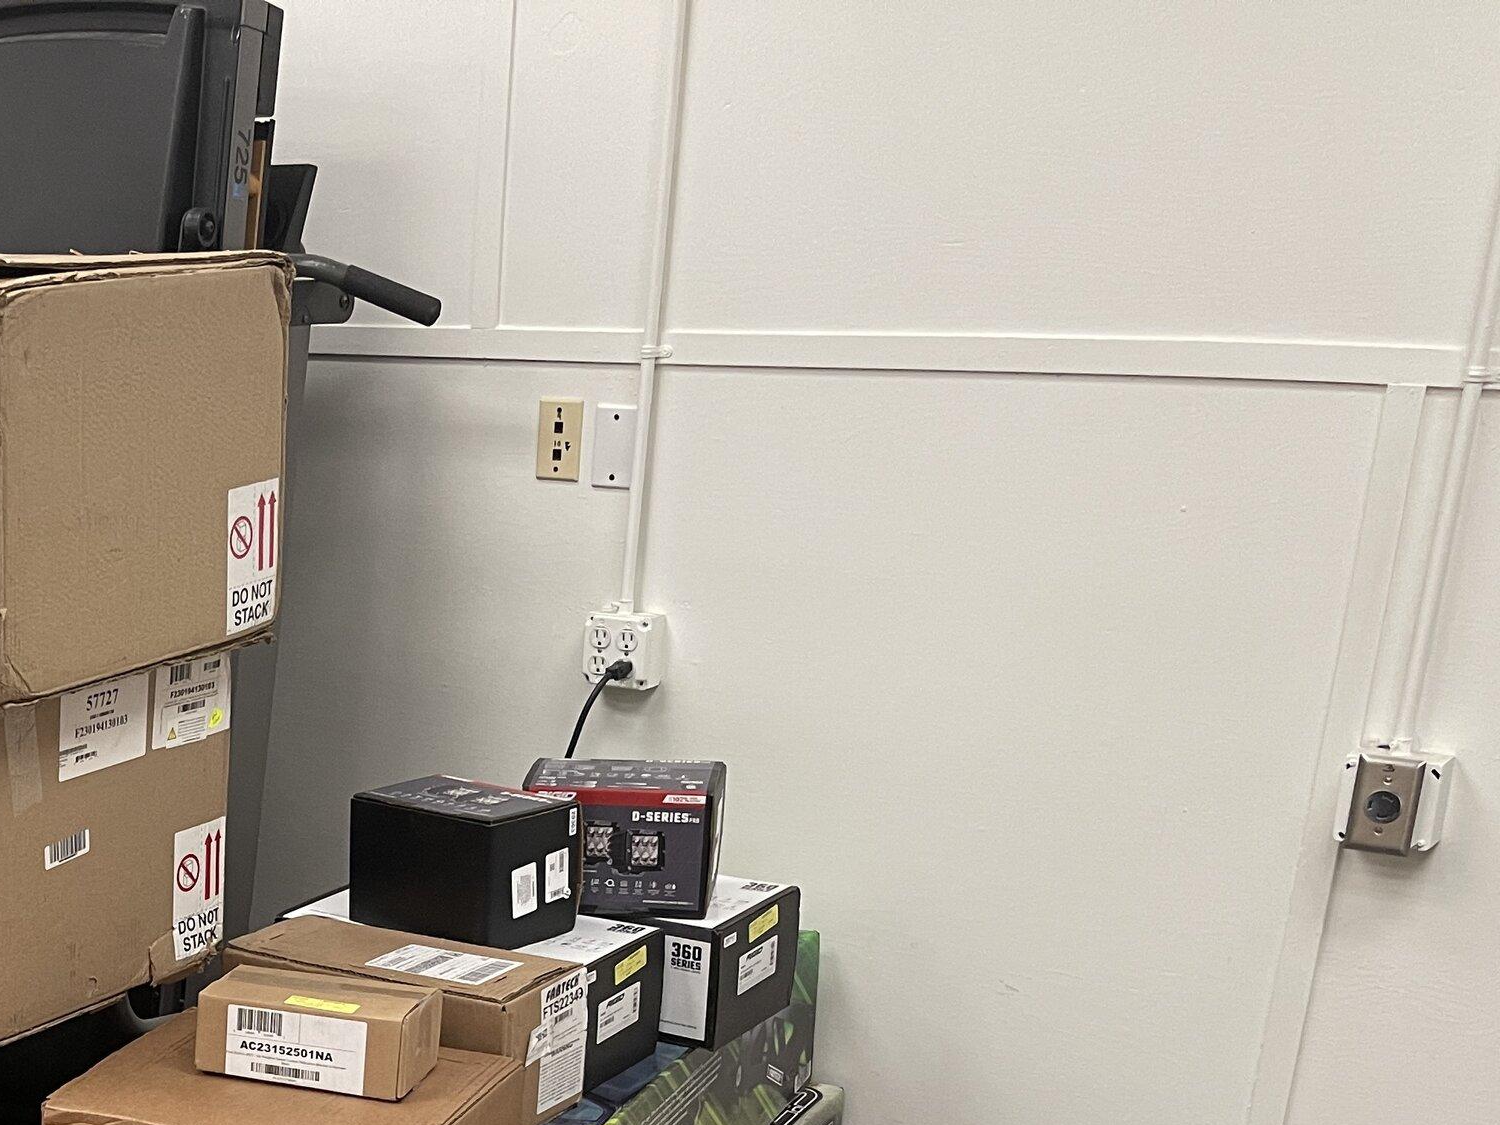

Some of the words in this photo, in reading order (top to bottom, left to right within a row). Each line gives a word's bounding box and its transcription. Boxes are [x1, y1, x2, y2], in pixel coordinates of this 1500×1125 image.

[234, 128, 252, 185] 725
[232, 587, 249, 607] DO
[251, 580, 273, 602] NOT
[234, 600, 269, 627] STACK
[86, 688, 119, 711] 57727
[631, 810, 689, 823] D-SERIES
[178, 917, 196, 935] DO
[198, 907, 219, 928] NOT
[183, 926, 218, 952] STACK
[671, 942, 703, 961] 360
[670, 957, 701, 971] SERIES
[240, 1040, 334, 1062] AC23152501NA
